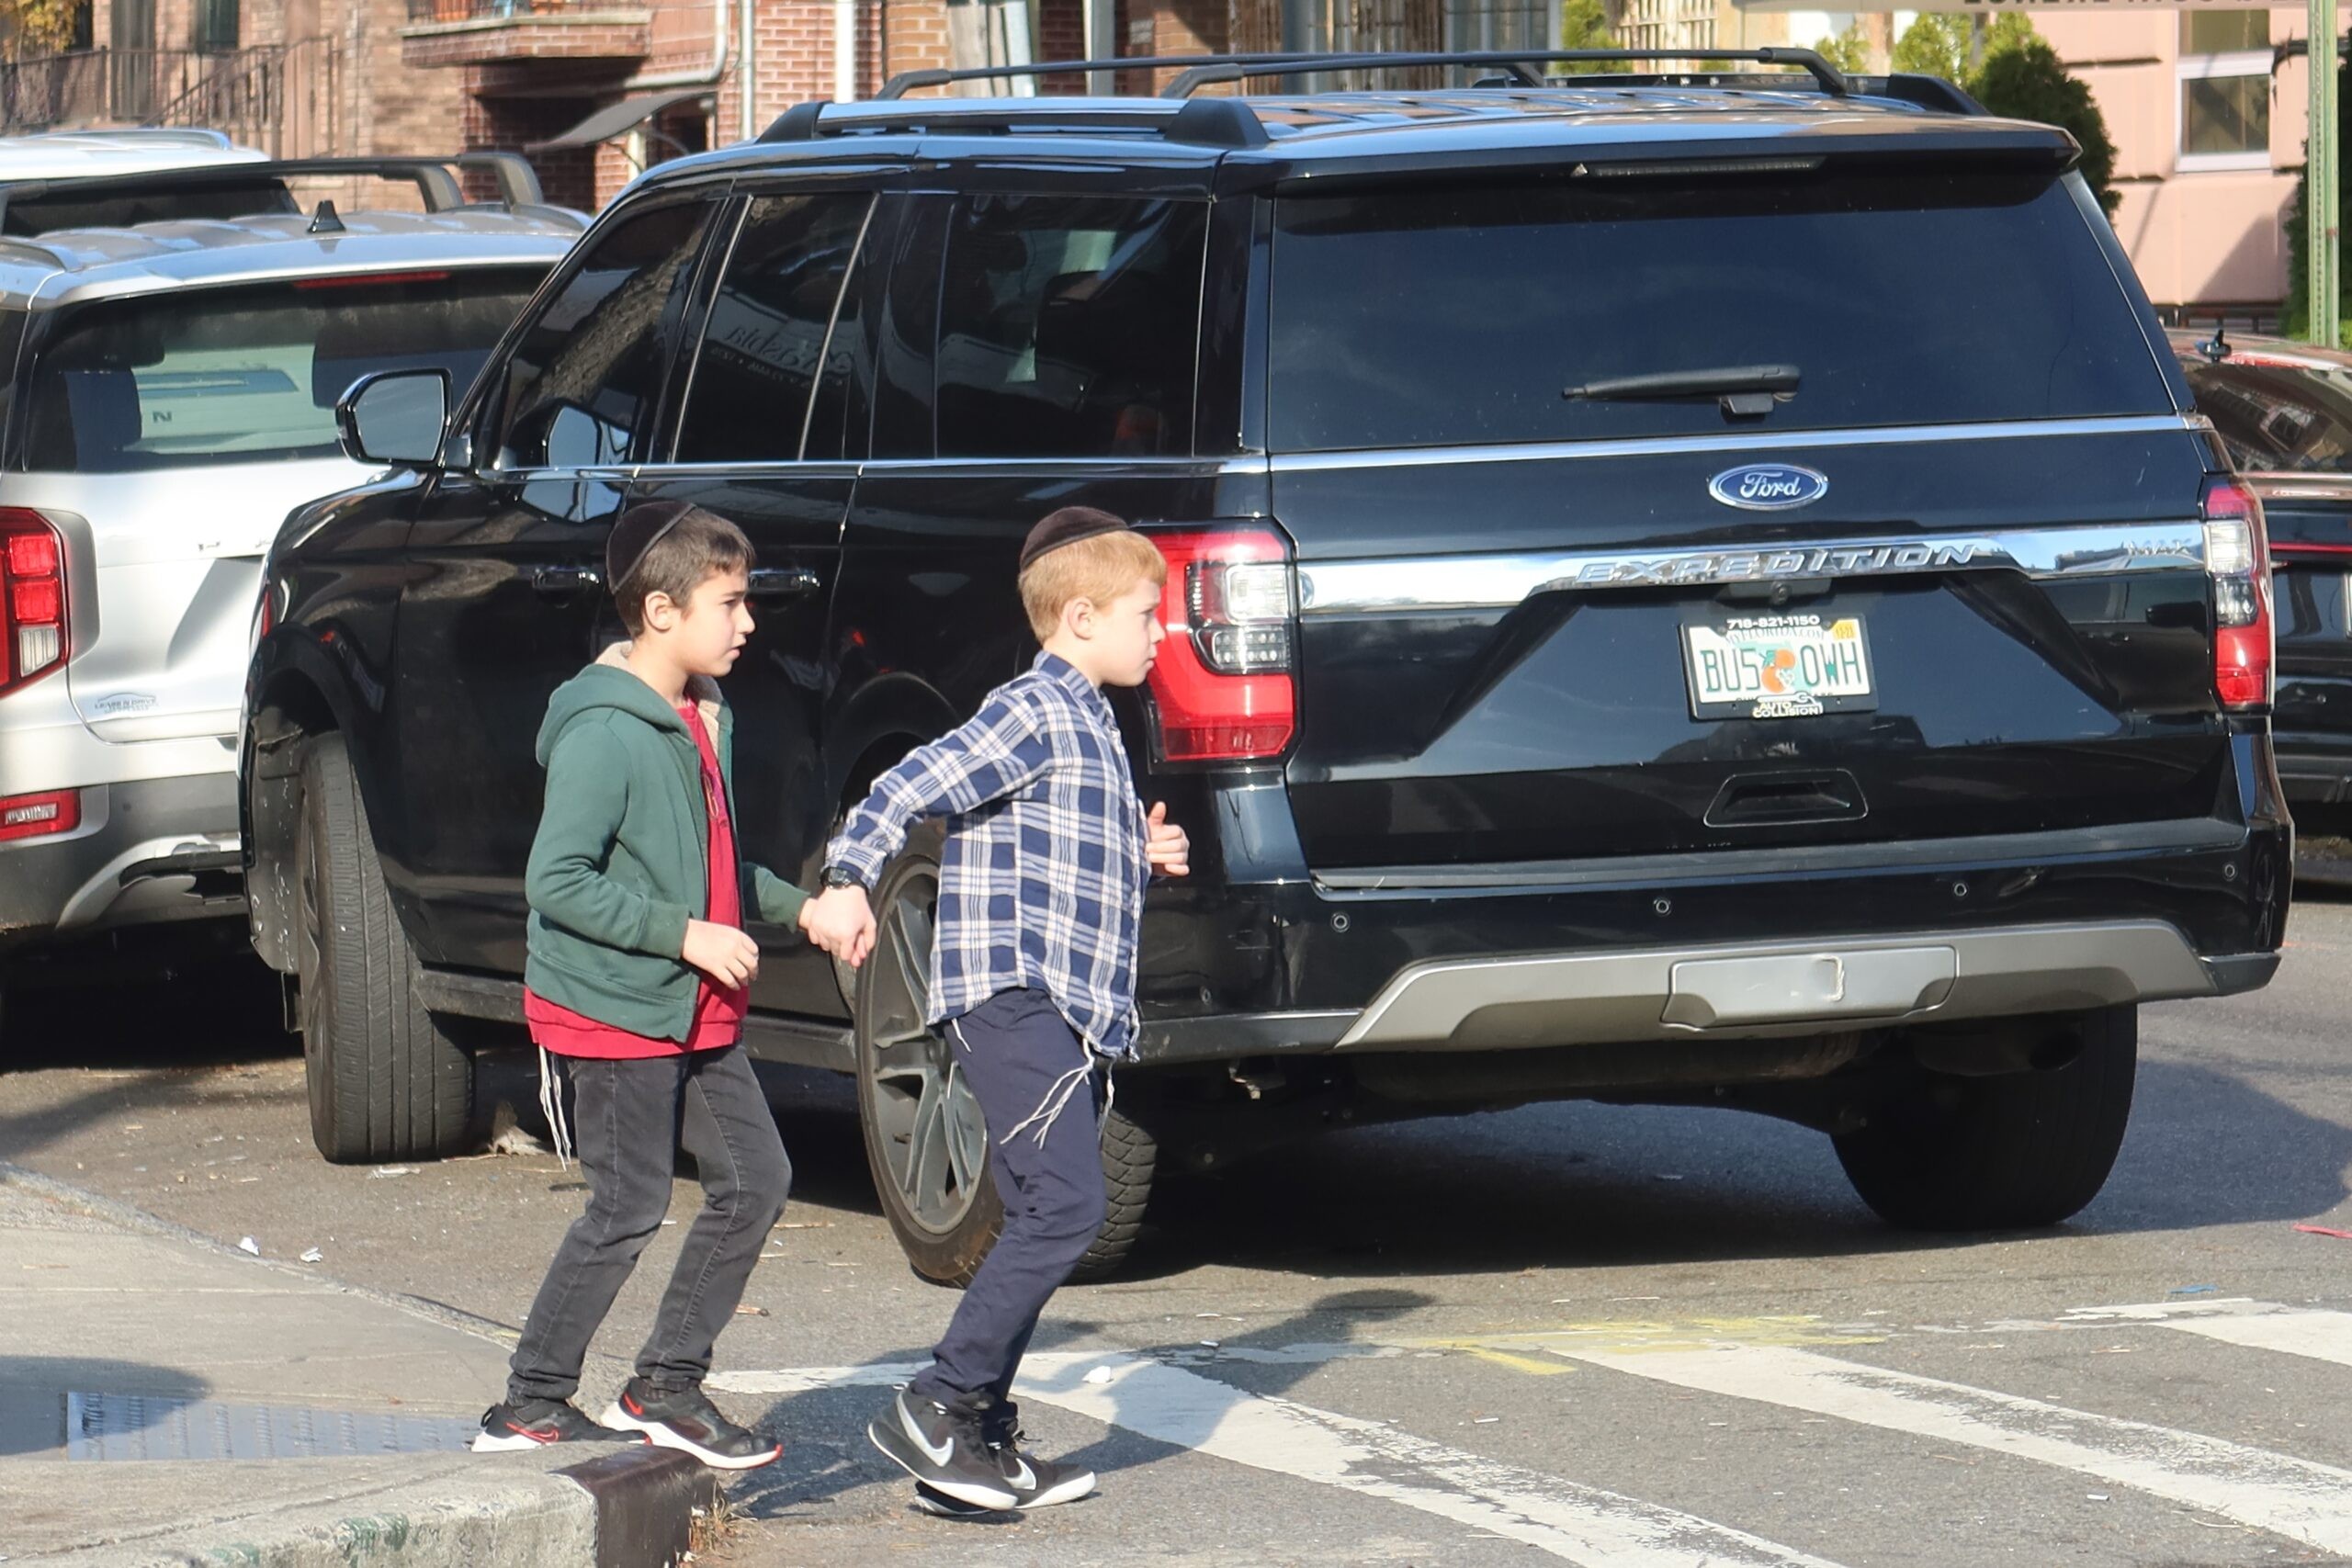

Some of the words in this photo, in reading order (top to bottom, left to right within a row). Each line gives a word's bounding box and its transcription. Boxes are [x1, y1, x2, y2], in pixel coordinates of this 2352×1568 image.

[1740, 471, 1801, 499] Ford
[1575, 544, 1977, 583] EXPEDITION
[1726, 615, 1821, 630] 718-821-1150
[1752, 707, 1819, 718] COLLISION
[1758, 701, 1792, 711] AUTO
